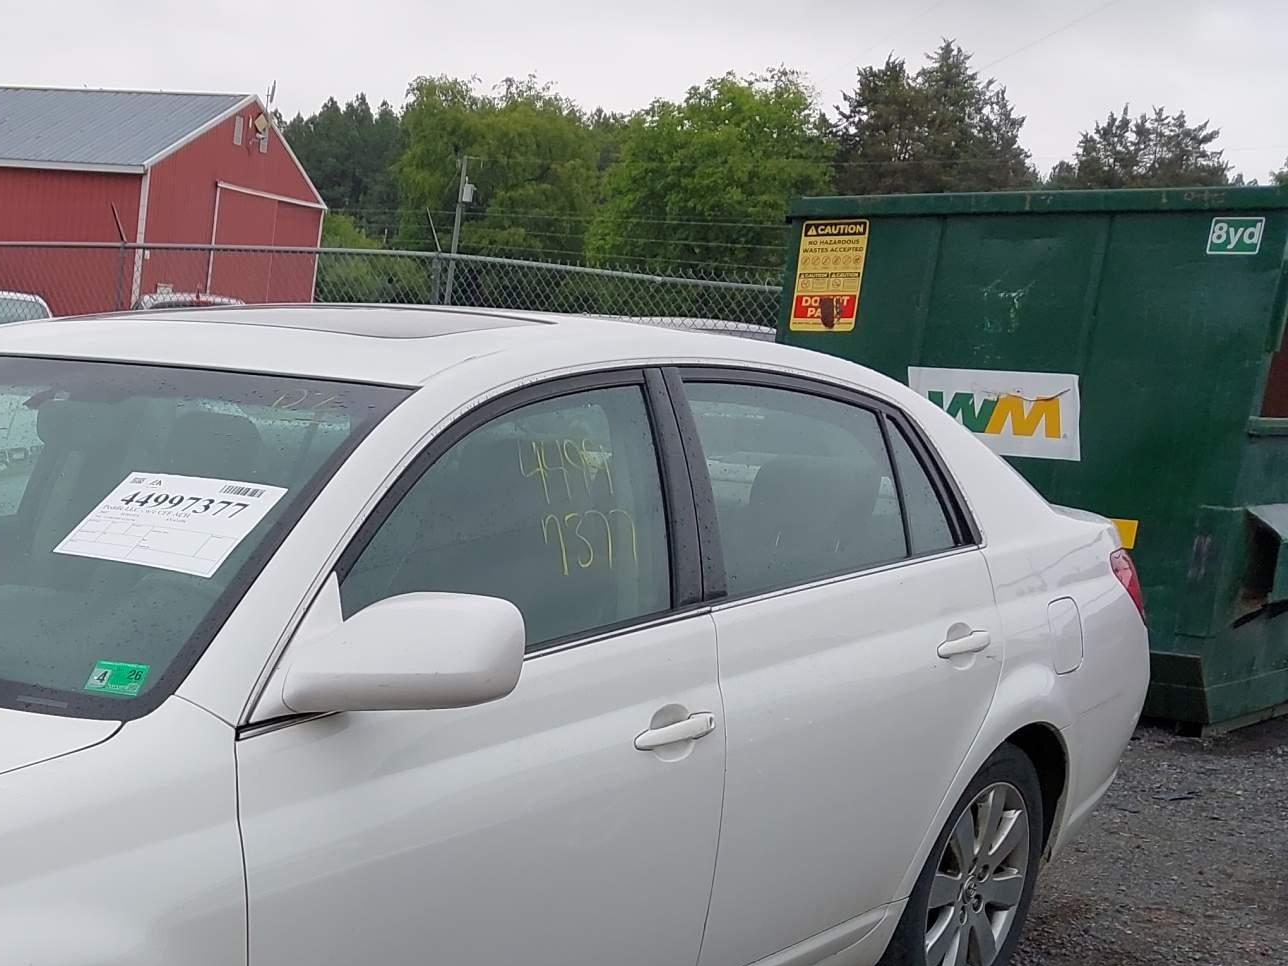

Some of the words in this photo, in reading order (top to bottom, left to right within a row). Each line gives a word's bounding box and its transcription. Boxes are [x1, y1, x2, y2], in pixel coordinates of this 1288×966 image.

[817, 224, 864, 235] CAUTION
[1212, 222, 1262, 249] 8yd
[820, 238, 860, 246] HAZARDOUS
[802, 296, 821, 306] DO
[927, 390, 1062, 439] WM
[120, 491, 251, 519] 44997377
[96, 670, 109, 683] 4
[127, 669, 144, 681] 26
